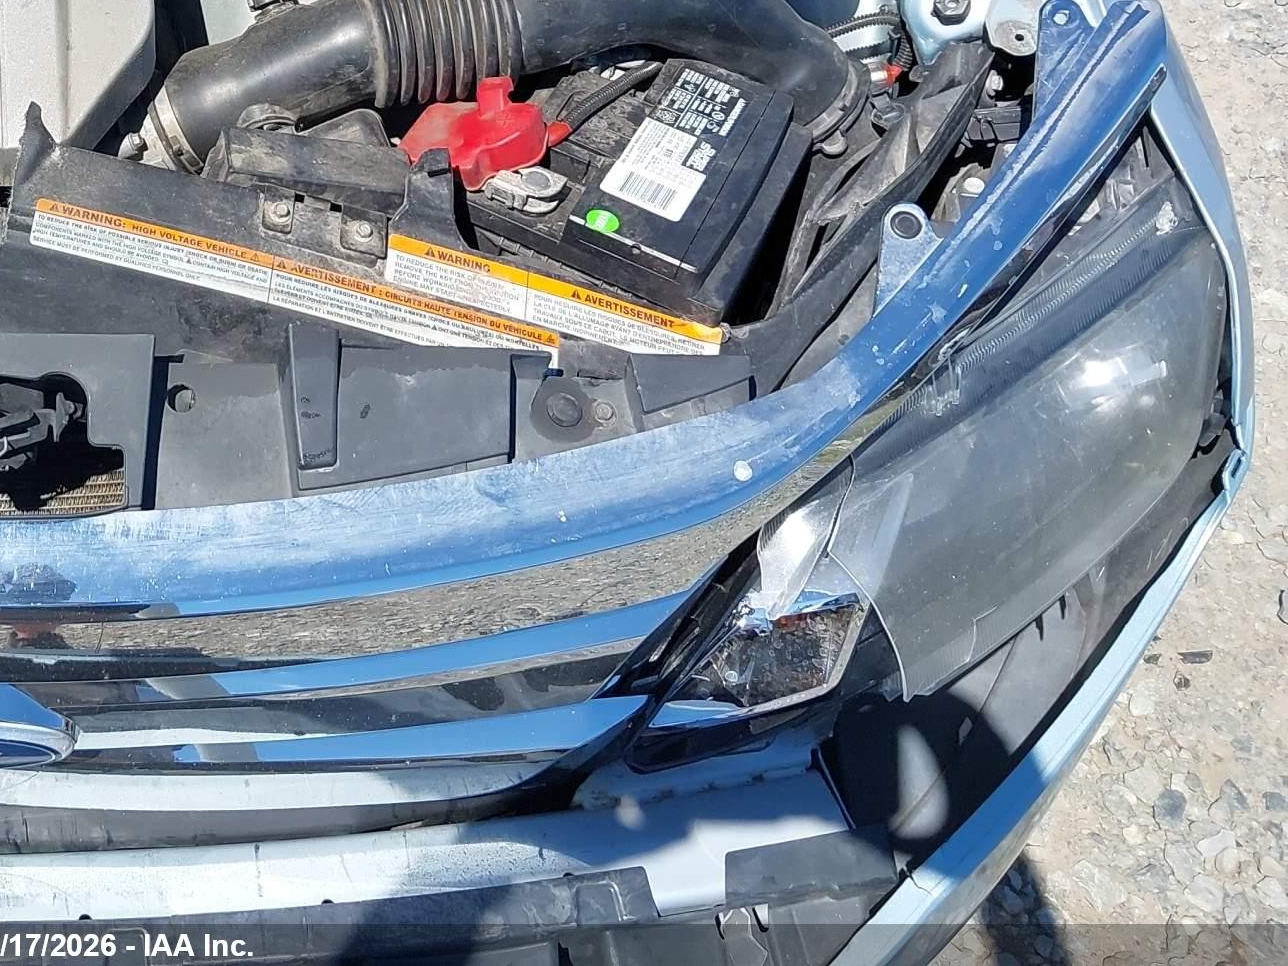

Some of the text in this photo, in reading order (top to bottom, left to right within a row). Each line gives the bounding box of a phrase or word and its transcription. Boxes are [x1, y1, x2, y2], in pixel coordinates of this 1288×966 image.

[61, 205, 247, 258] WARNING: HIGH VOLTAGE VEHICLE
[405, 257, 434, 269] REDUCE
[435, 265, 448, 273] THE
[449, 269, 465, 278] RISK
[435, 251, 491, 273] WARNING
[290, 263, 376, 293] AVERTISSEMENT
[384, 291, 422, 306] CIRCUITS
[423, 301, 451, 314] HAUTE
[453, 310, 487, 324] TENSION
[489, 320, 501, 328] DU
[584, 293, 675, 328] AVERTISSEMENT
